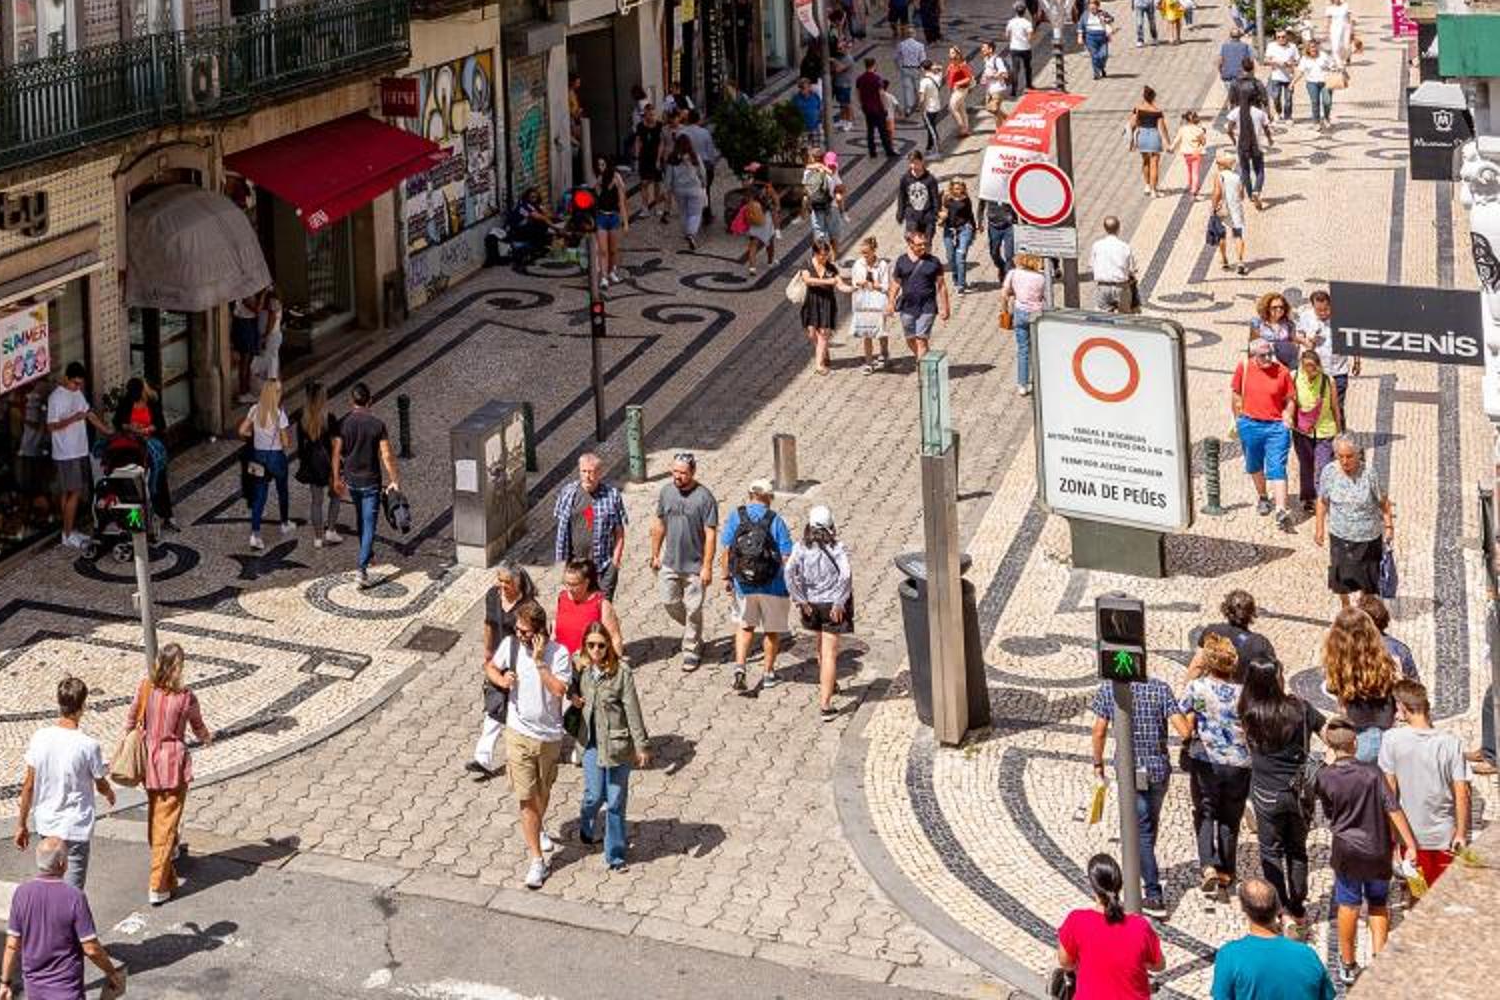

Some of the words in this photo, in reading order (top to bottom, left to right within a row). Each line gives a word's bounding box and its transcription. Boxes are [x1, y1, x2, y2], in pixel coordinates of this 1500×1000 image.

[3, 323, 47, 355] SUMMER
[1060, 478, 1097, 497] ZONA
[1102, 484, 1119, 500] DE
[1124, 486, 1167, 509] PEÕES
